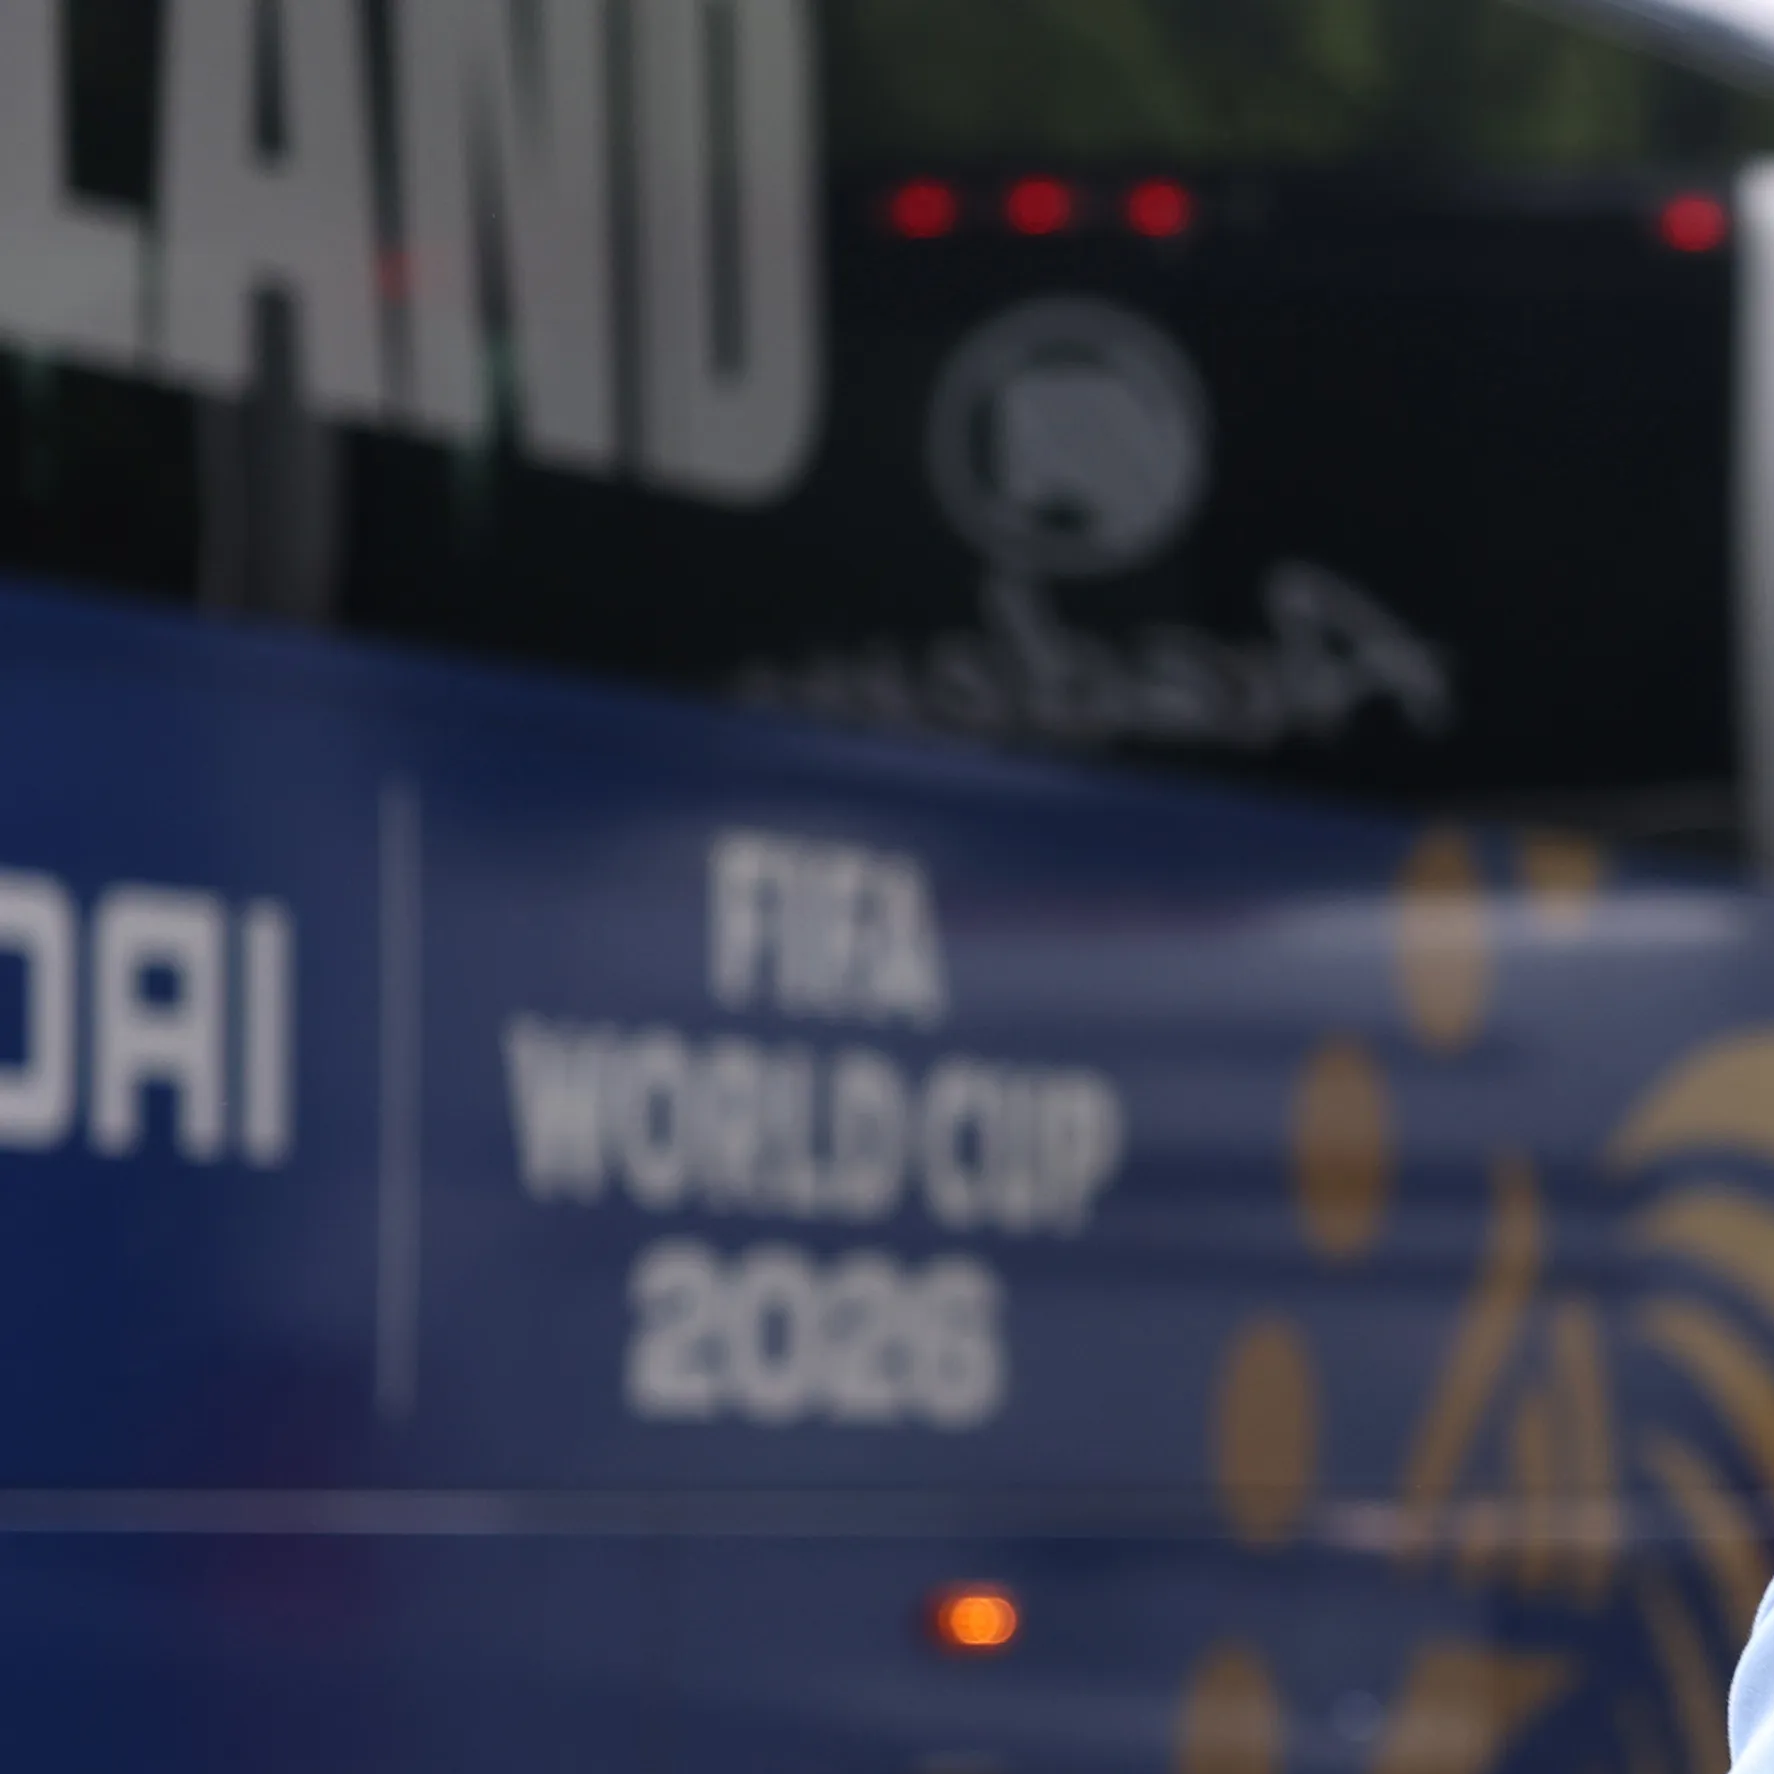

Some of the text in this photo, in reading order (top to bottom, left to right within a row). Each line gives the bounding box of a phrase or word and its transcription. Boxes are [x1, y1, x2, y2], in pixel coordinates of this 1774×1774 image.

[707, 828, 947, 1028] FIFA
[504, 1014, 1123, 1236] WORLD CUP
[625, 1239, 1003, 1429] 2026
